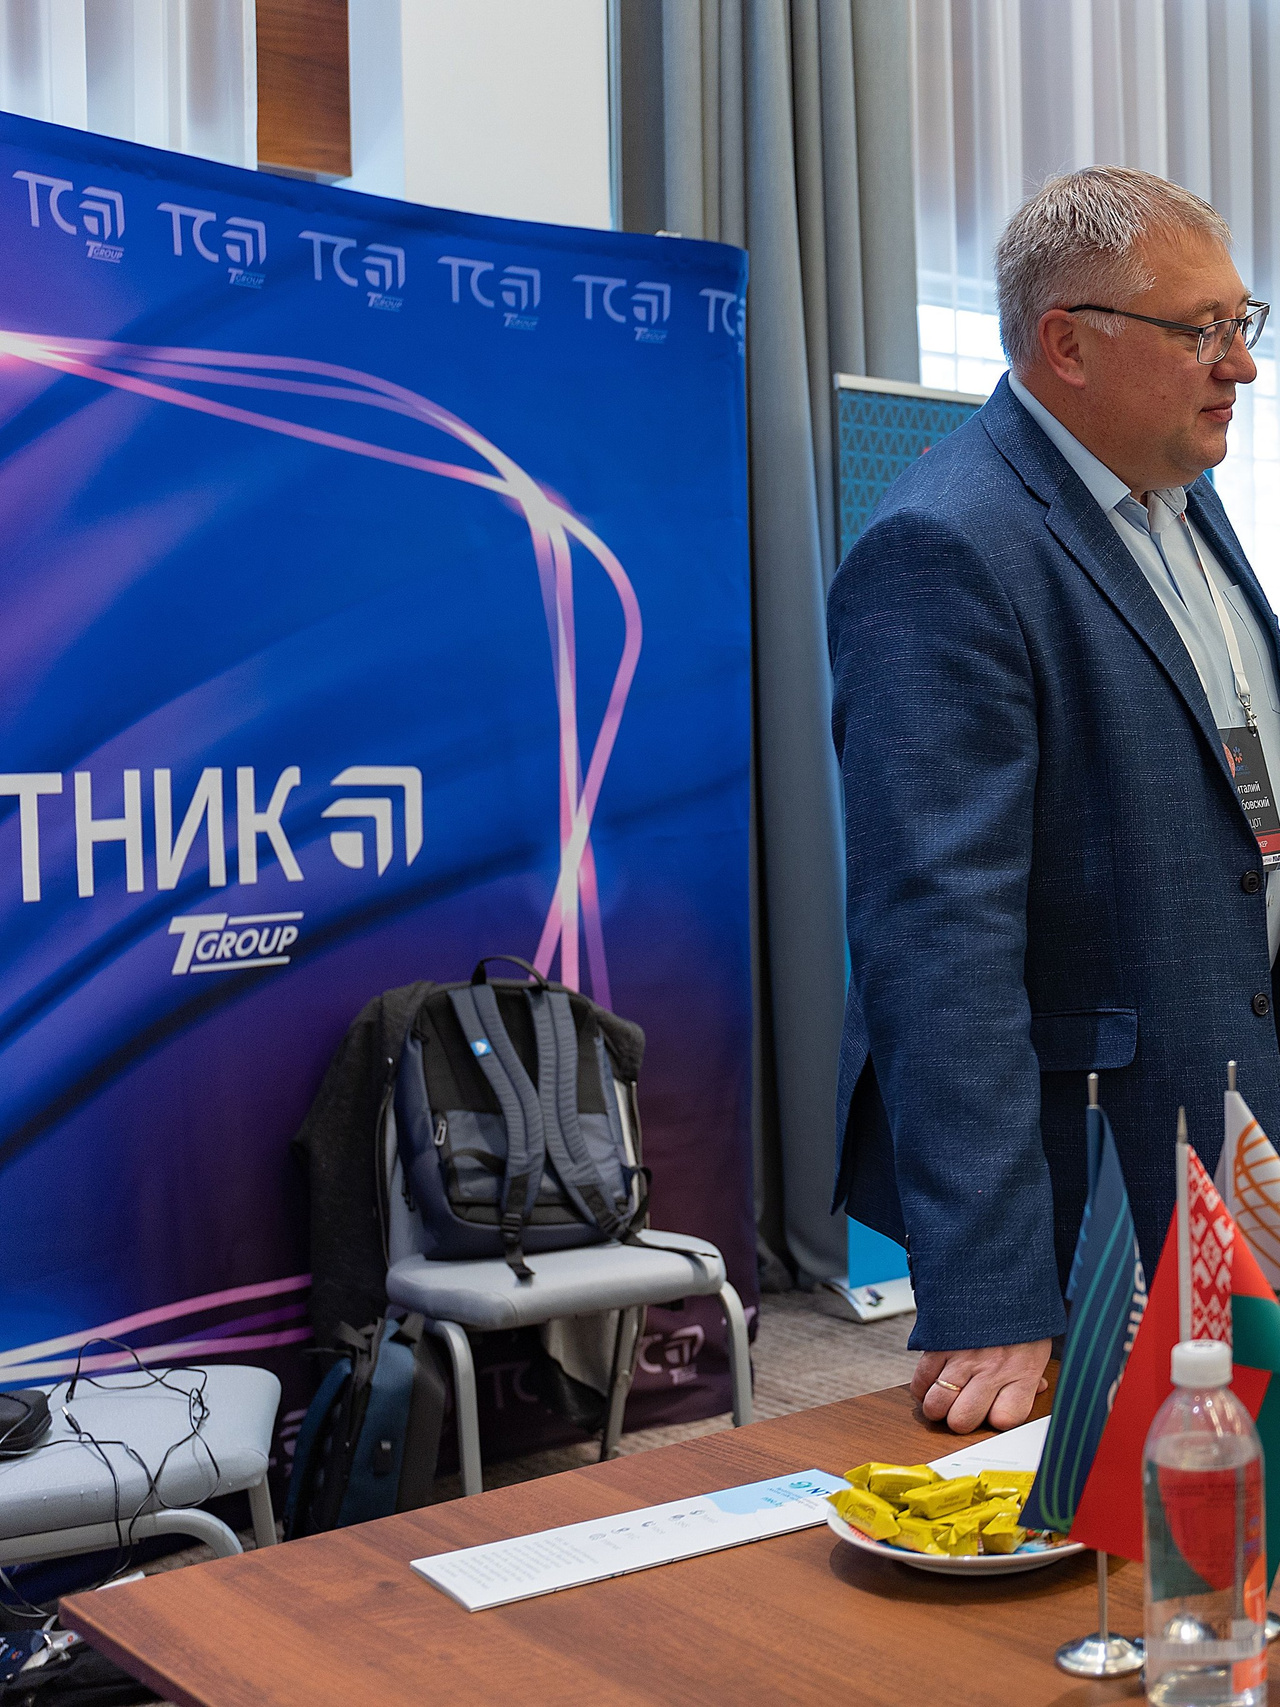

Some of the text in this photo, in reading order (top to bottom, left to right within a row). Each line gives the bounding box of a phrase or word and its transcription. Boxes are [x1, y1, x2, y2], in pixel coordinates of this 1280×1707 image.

[1237, 780, 1261, 794] италий
[1241, 796, 1271, 811] бовский
[1250, 817, 1262, 829] ЦОТ
[0, 765, 304, 902] ТНИК
